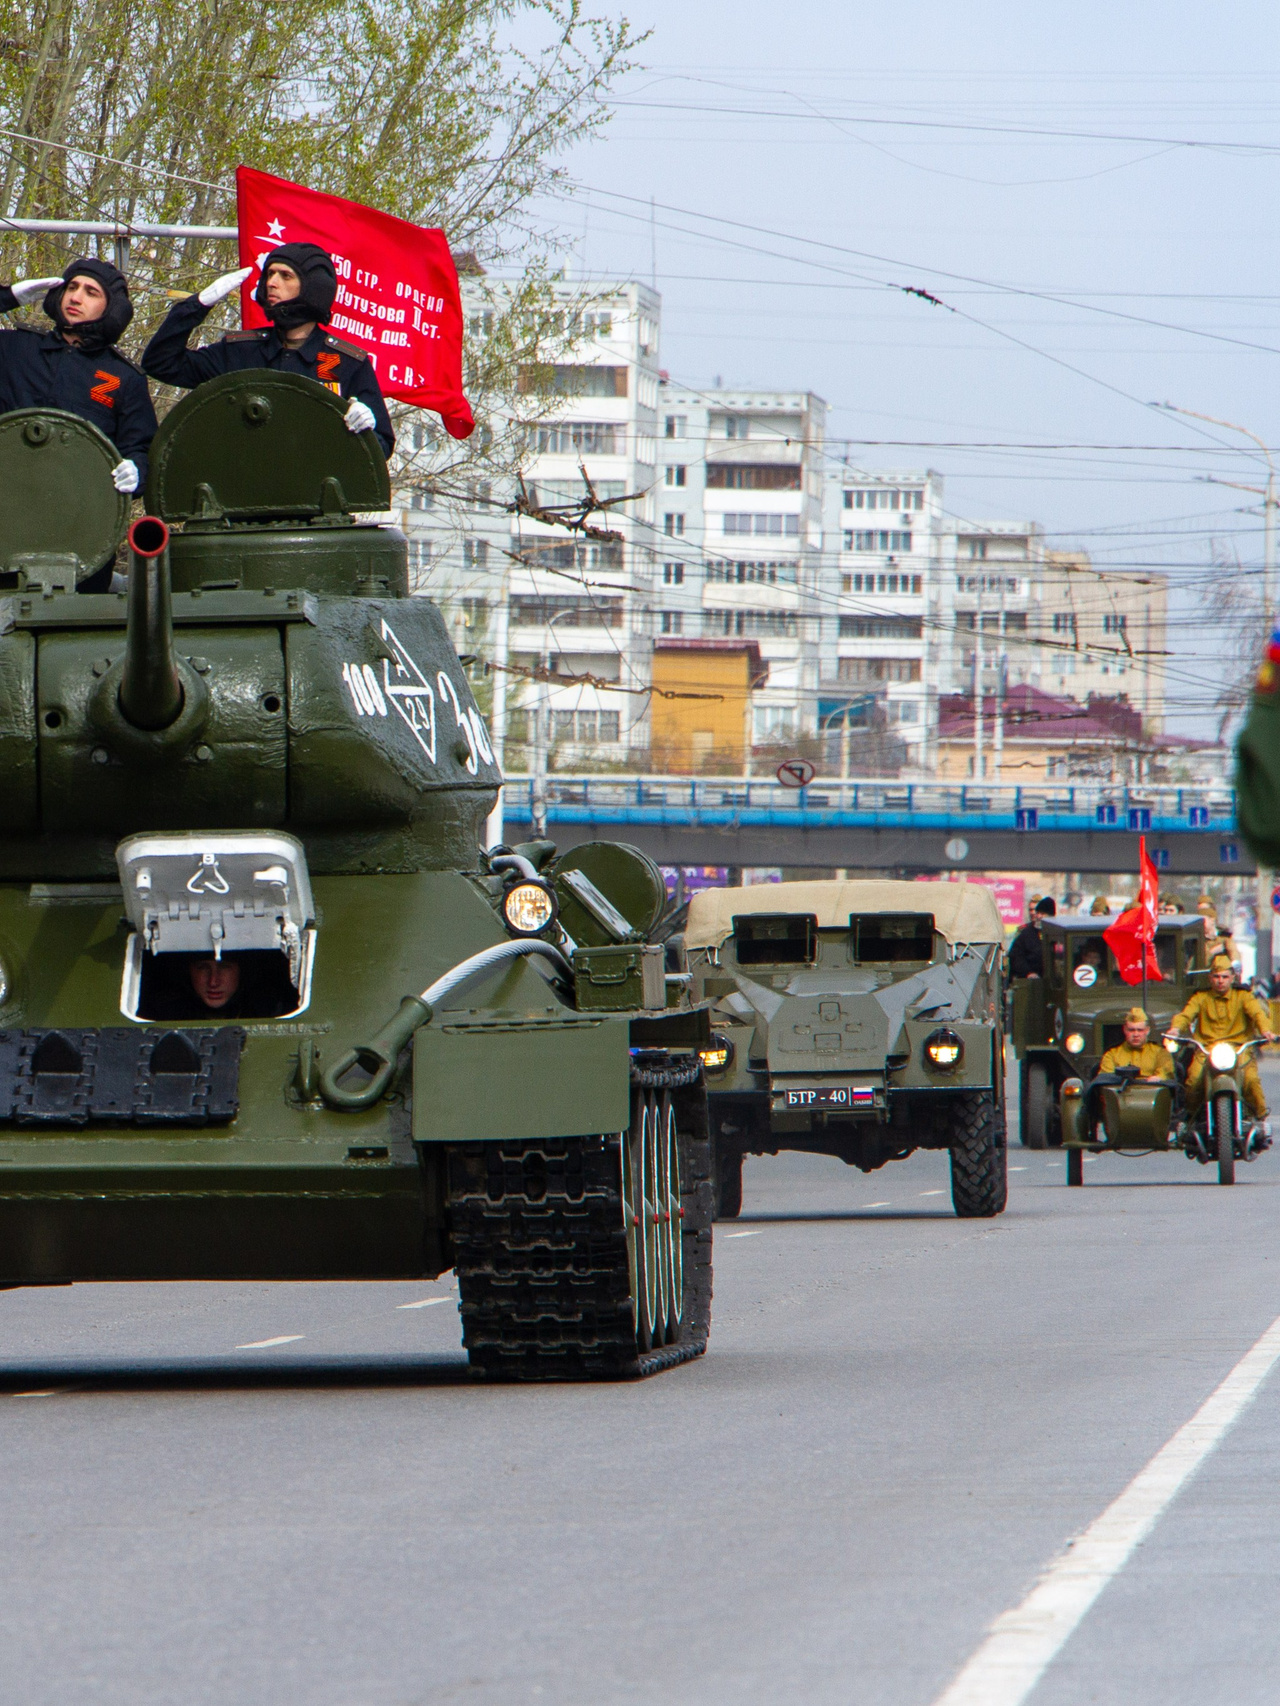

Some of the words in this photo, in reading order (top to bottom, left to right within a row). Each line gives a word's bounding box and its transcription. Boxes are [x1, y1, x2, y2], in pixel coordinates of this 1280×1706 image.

[396, 282, 444, 313] ОРДЕНА
[330, 312, 377, 342] ДРИЦК.
[380, 330, 411, 348] ДИВ.
[342, 662, 388, 717] 100
[405, 697, 431, 730] 29
[788, 1091, 816, 1105] БТР
[829, 1090, 846, 1103] 40
